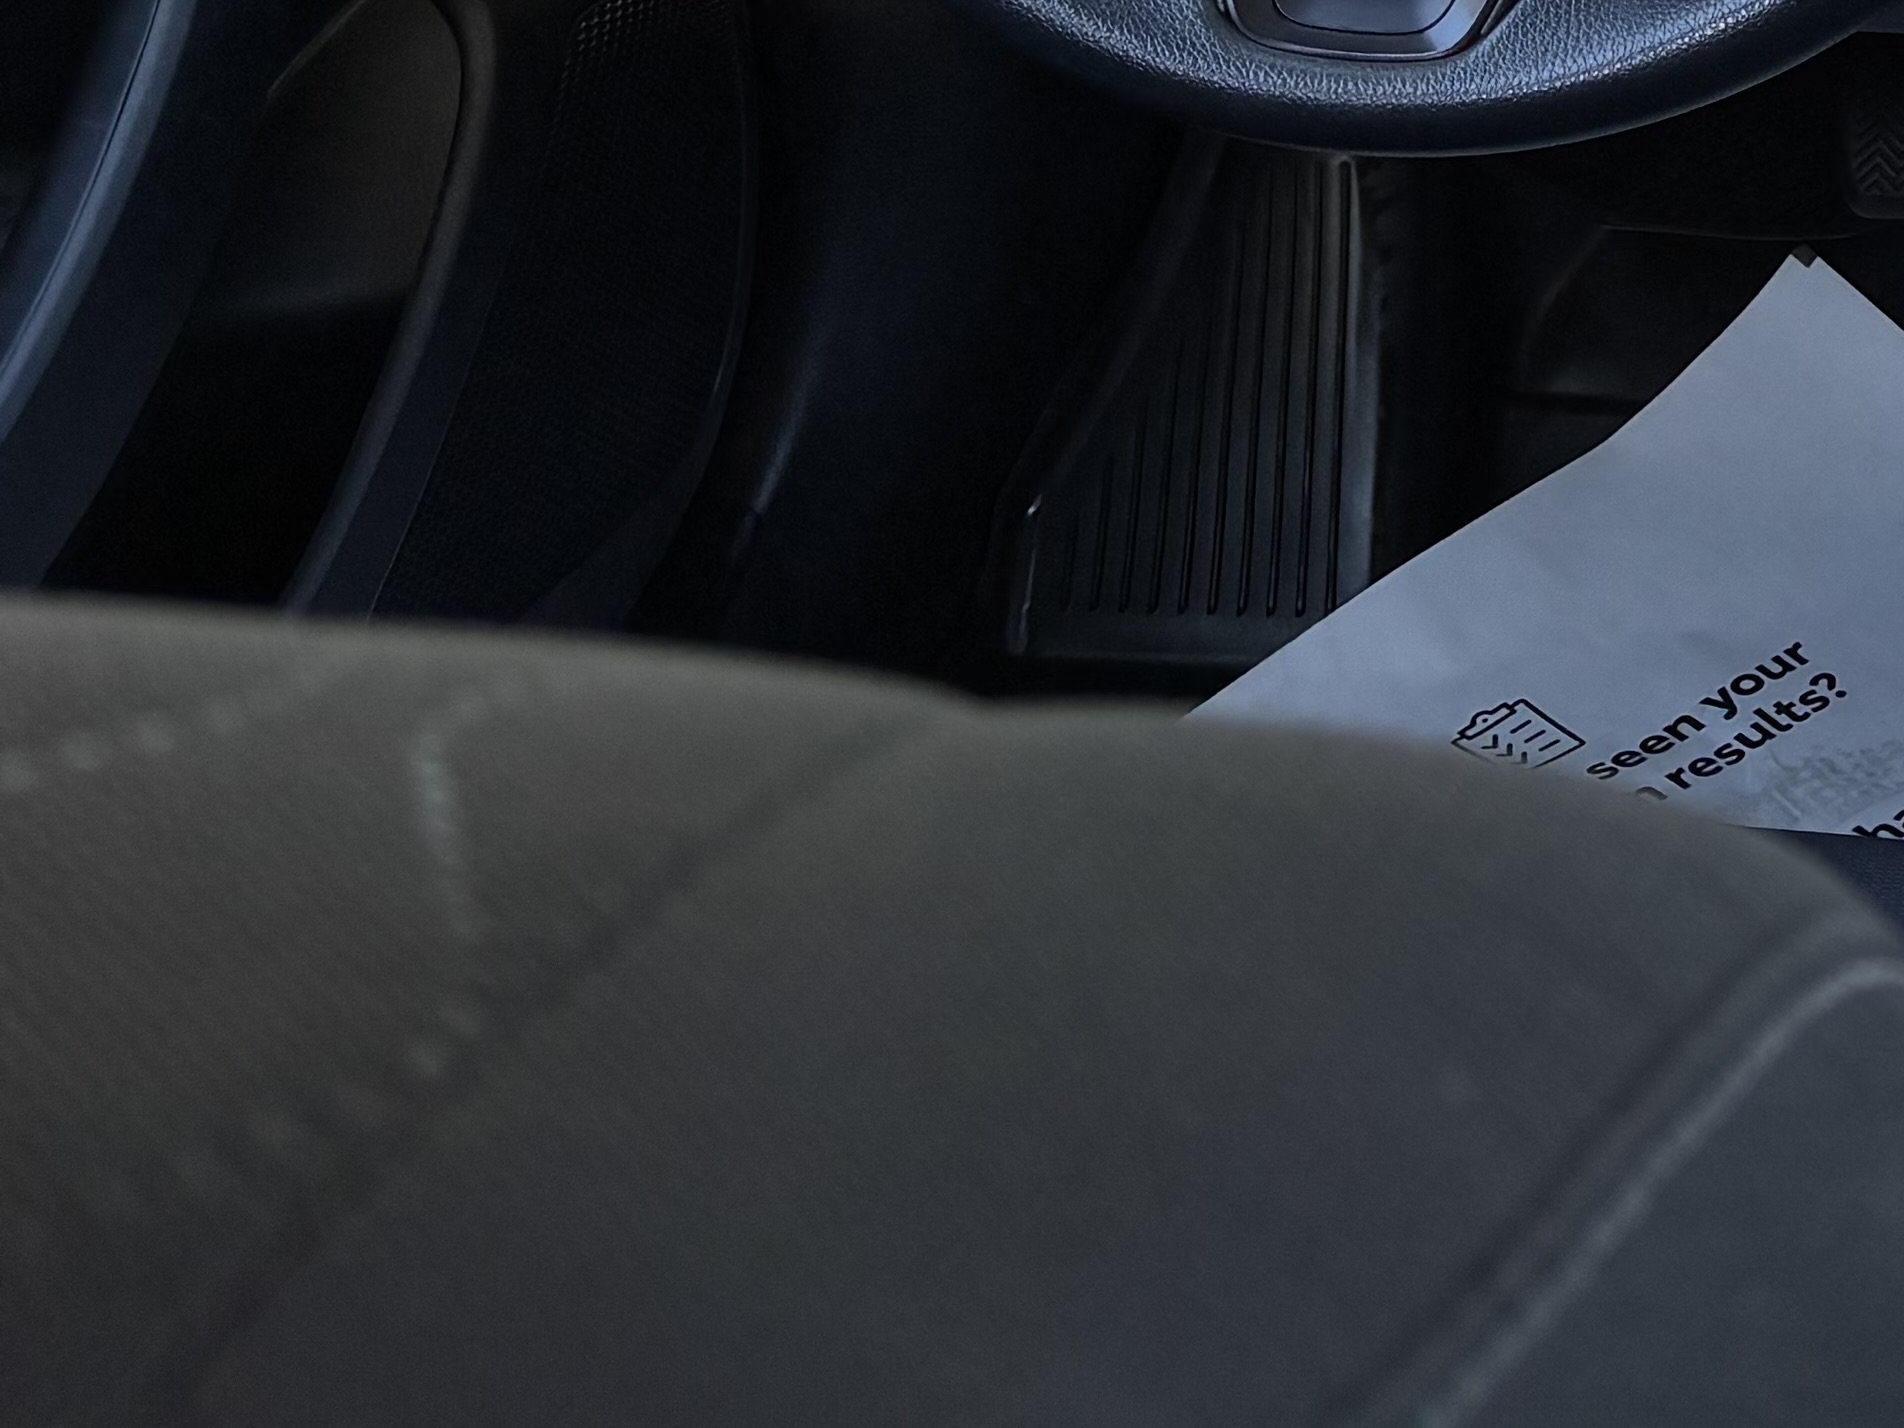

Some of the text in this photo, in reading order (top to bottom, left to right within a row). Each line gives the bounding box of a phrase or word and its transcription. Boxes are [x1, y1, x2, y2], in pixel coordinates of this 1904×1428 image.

[1586, 641, 1810, 780] seen your
[1664, 671, 1847, 790] results?
